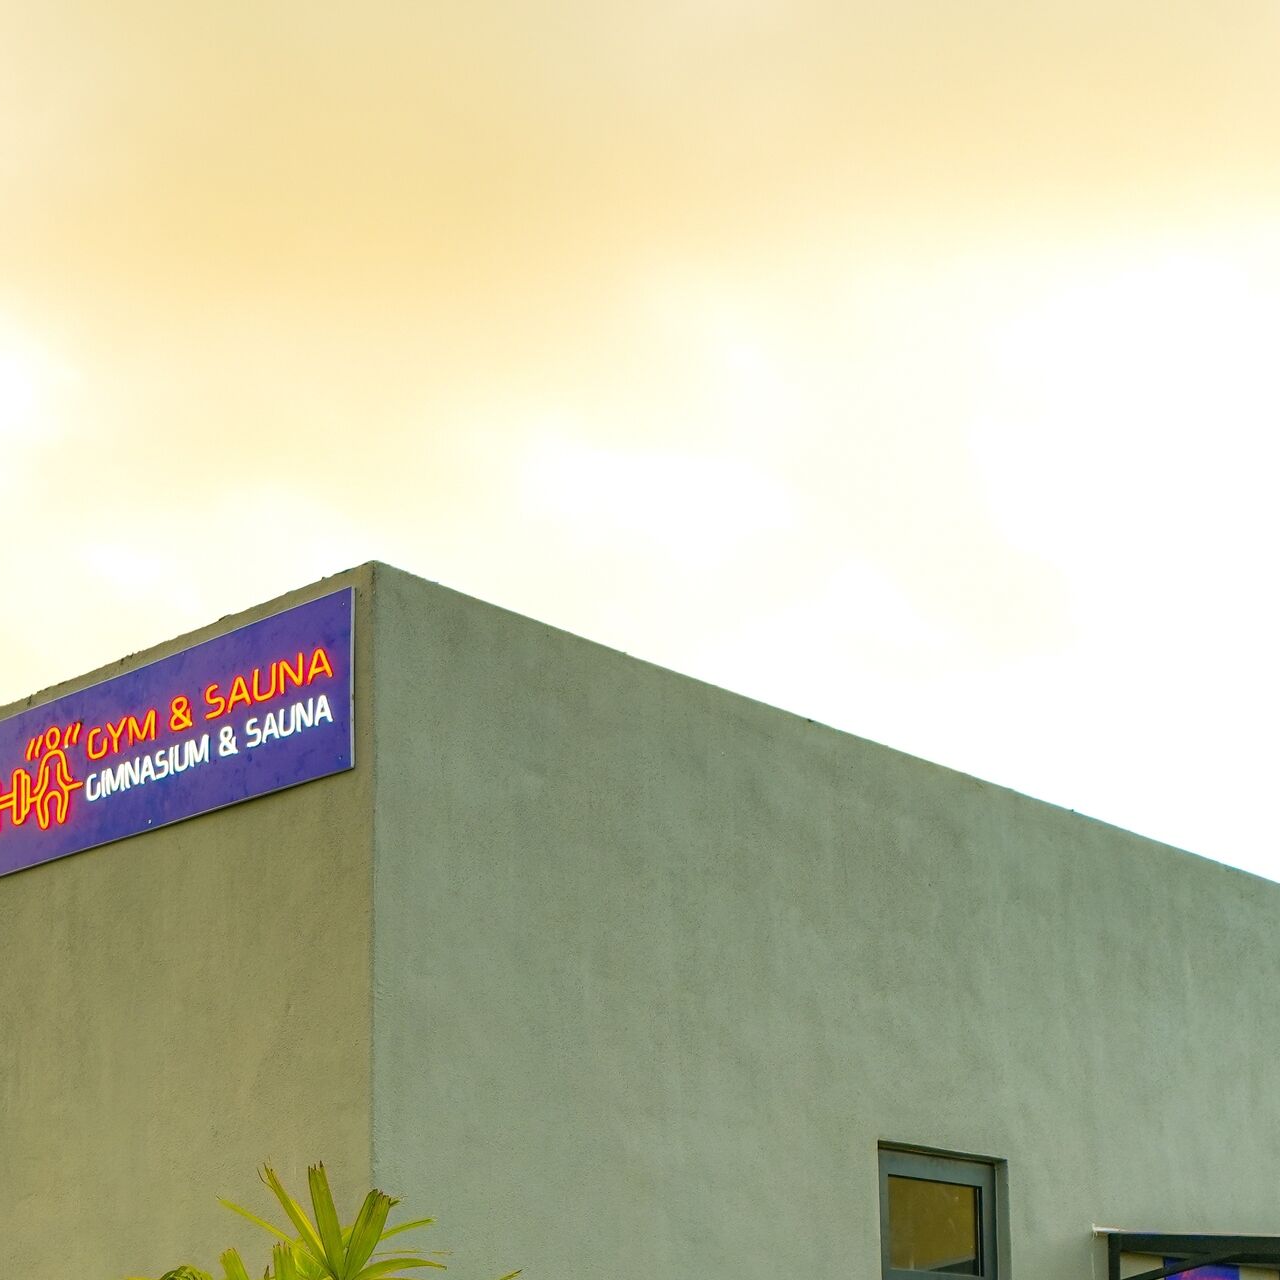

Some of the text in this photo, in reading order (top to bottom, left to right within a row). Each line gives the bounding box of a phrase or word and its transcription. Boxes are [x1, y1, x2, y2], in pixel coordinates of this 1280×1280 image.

[86, 648, 334, 760] GYM & SAUNA
[86, 694, 334, 802] GIMNASIUM & SAUNA
